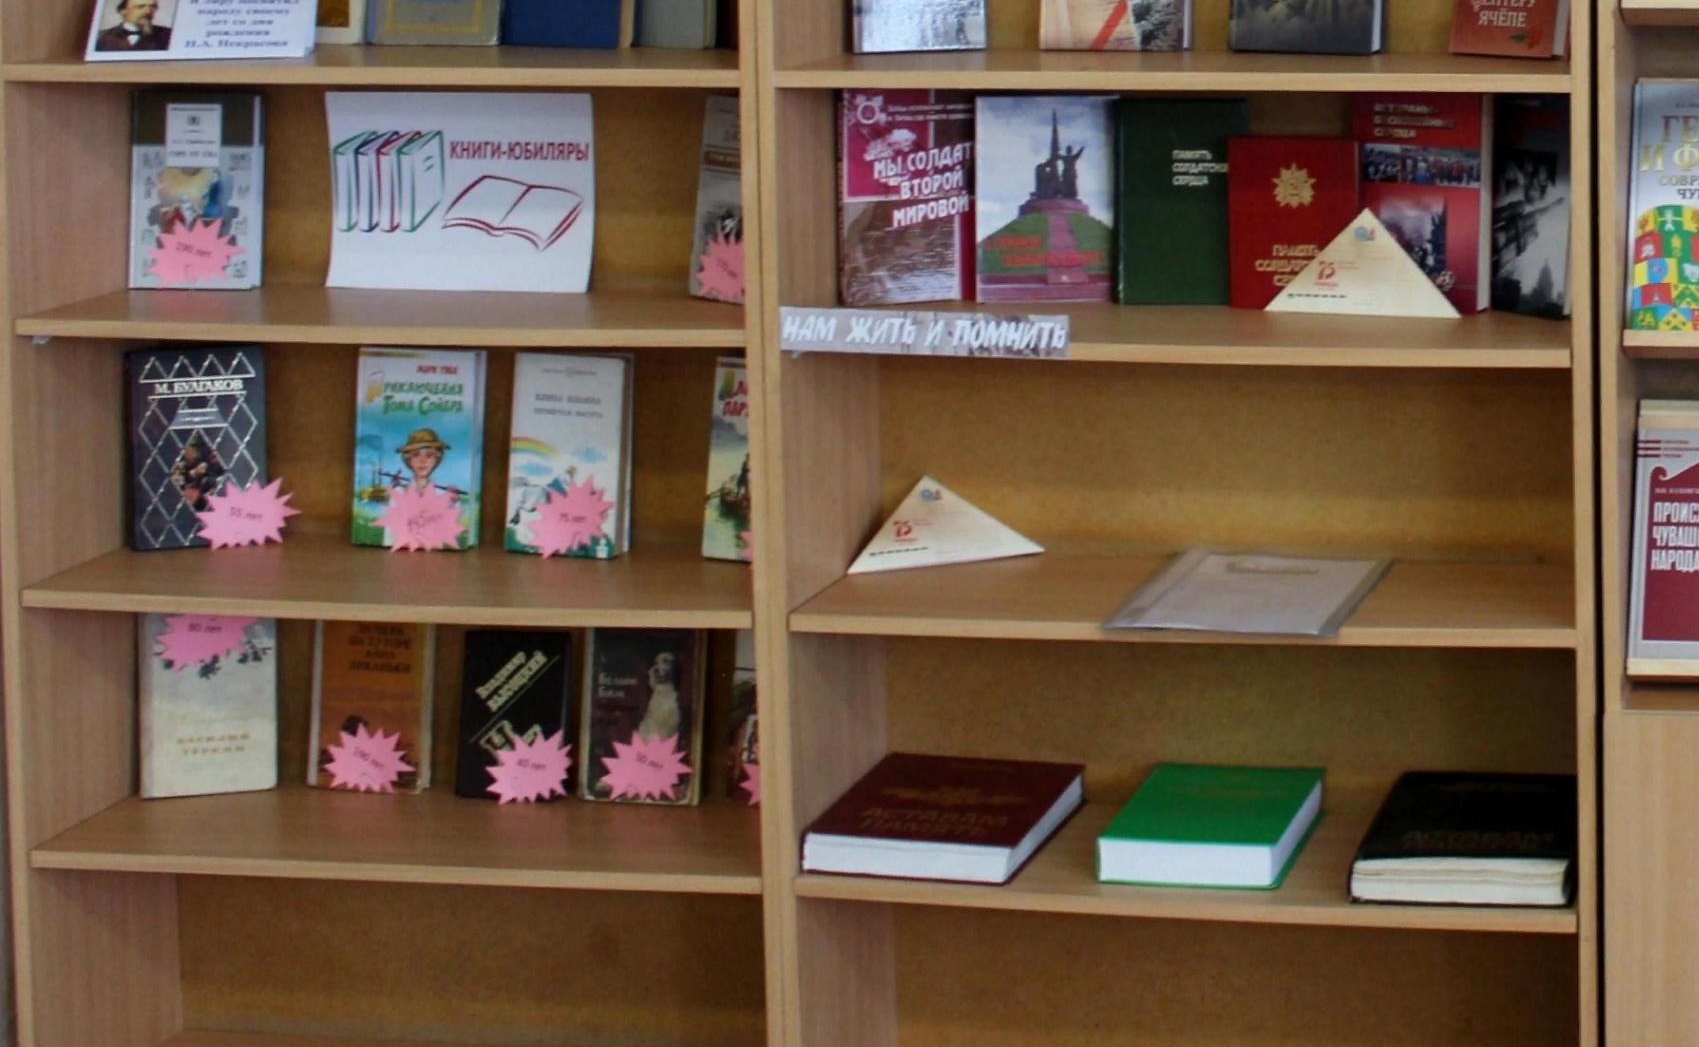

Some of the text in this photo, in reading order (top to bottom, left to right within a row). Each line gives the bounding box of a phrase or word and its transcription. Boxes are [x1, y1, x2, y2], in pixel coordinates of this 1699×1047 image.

[449, 140, 589, 161] КНИГИ-ЮБИЛЯРЫ
[1640, 145, 1665, 172] И
[873, 156, 900, 180] МЫ
[900, 167, 964, 200] ВТОРОЙ
[891, 193, 970, 229] МИРОВОЙ
[783, 315, 1067, 350] НАМ ЖИТЬ И ПОМНИТЬ
[154, 379, 244, 394] М. БУЛГАКОВ
